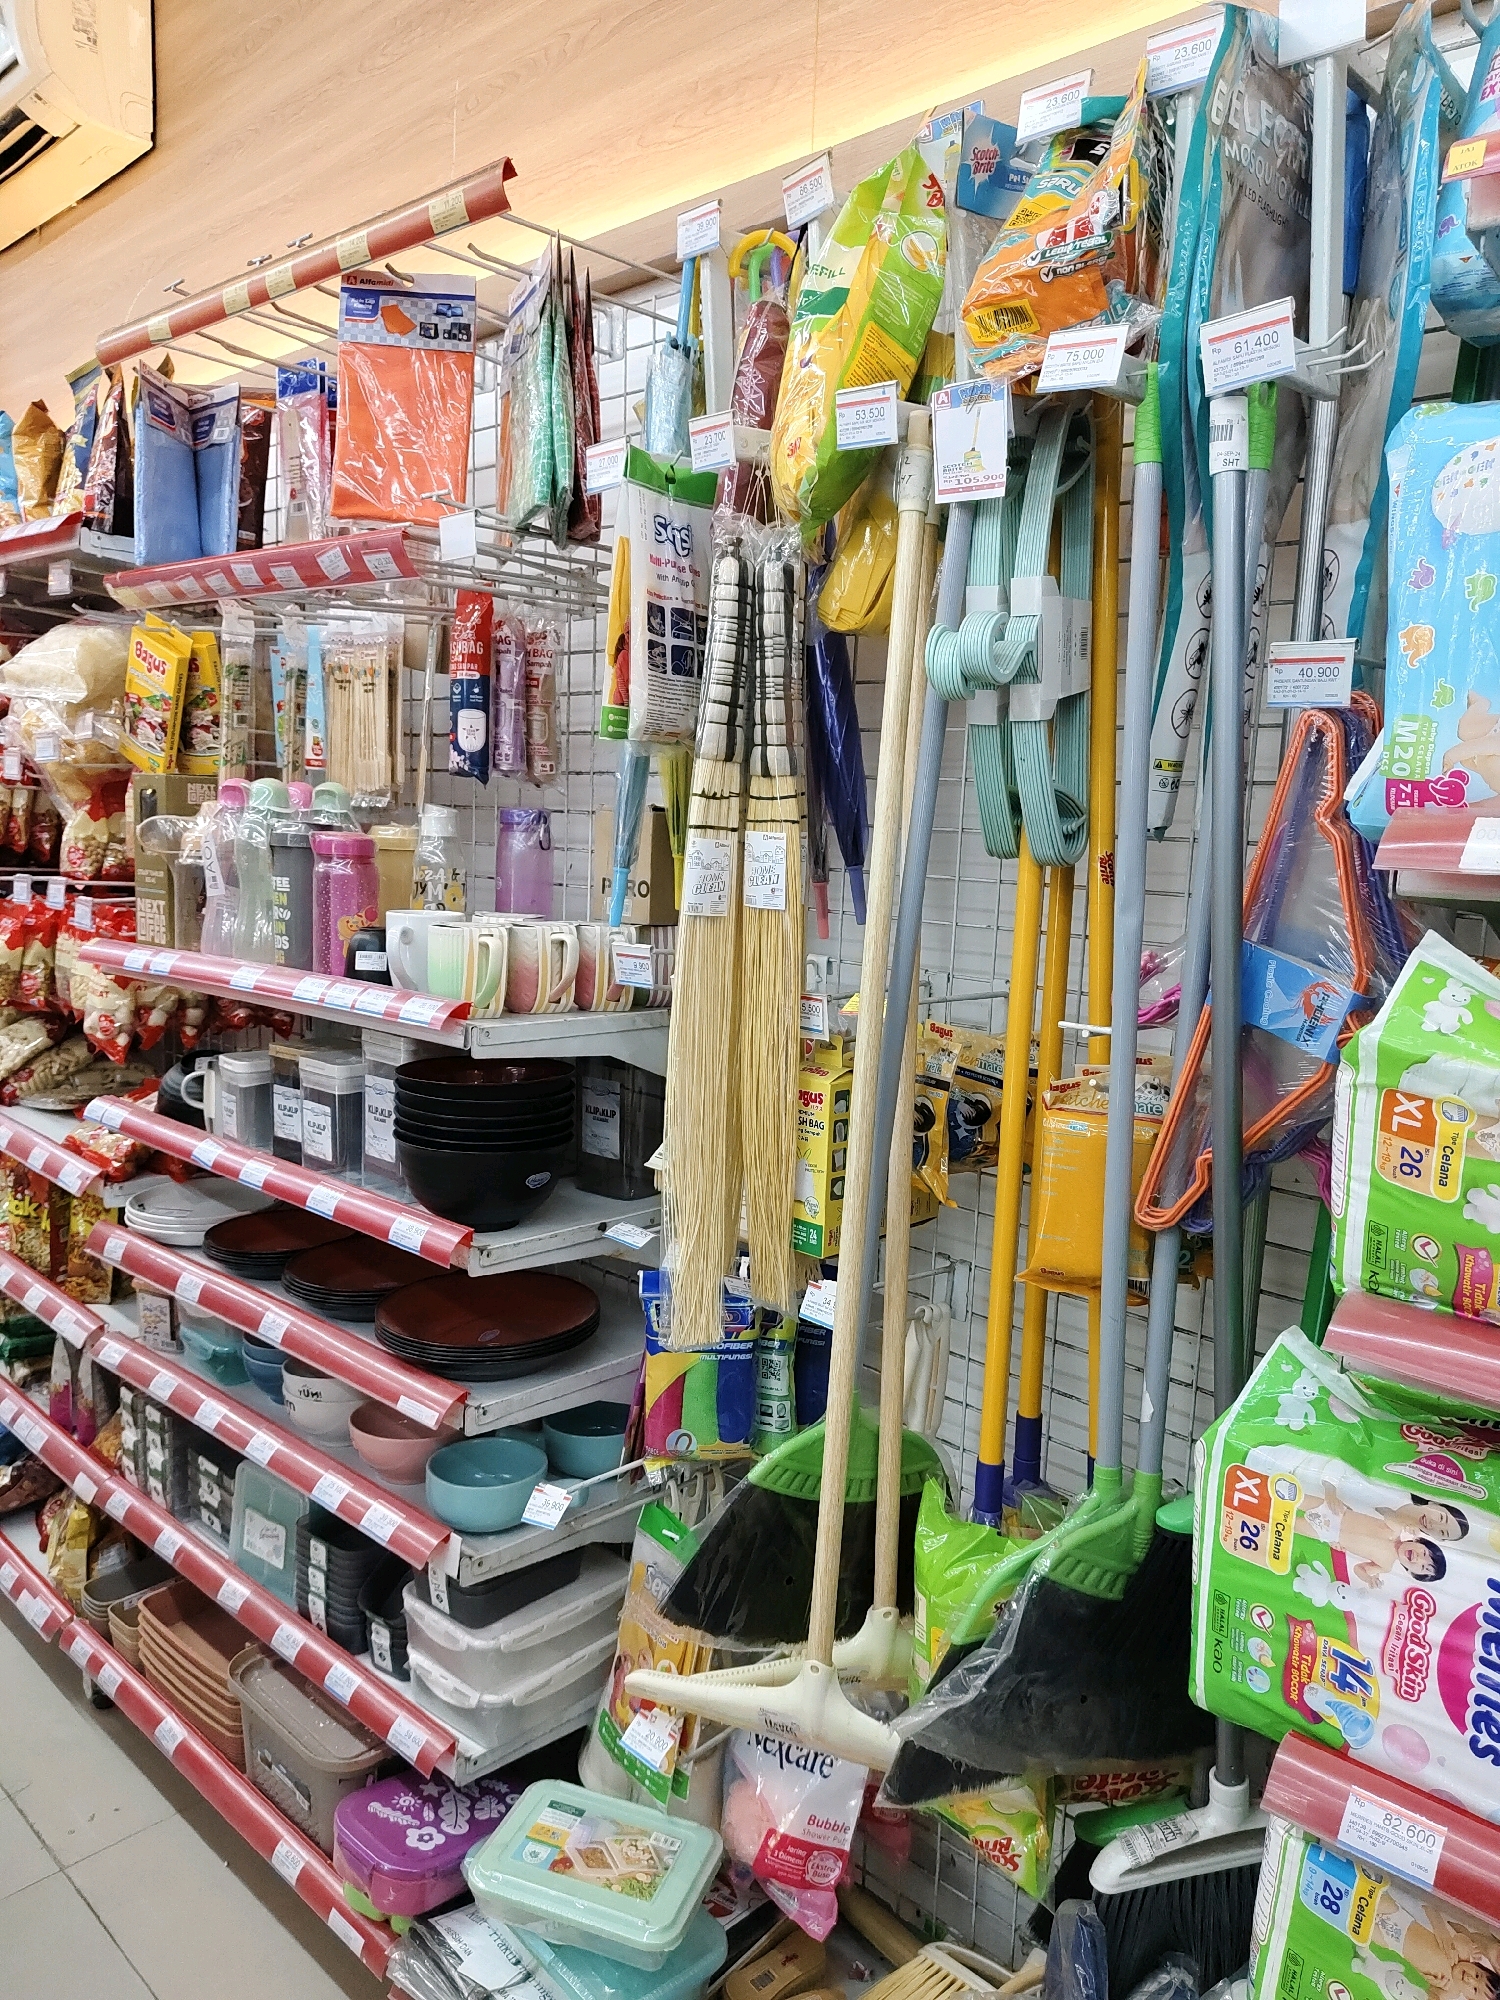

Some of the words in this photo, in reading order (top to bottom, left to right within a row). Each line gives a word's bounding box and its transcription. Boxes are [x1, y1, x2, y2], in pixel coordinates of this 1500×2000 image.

[1174, 38, 1212, 60] 23.600
[1045, 89, 1080, 109] 23.600
[972, 161, 995, 175] Brite
[696, 216, 717, 232] 39.900
[360, 278, 394, 286] Alfamidi
[807, 264, 846, 279] EFILL
[1234, 331, 1280, 354] 61.400
[1066, 348, 1105, 362] 75.000
[704, 431, 726, 446] 23.700
[598, 455, 619, 468] 27.000
[942, 461, 973, 469] SCOTCH
[1222, 458, 1240, 467] SHT
[954, 474, 1005, 486] 105.900
[134, 640, 168, 675] Bagus
[1274, 667, 1283, 675] Rp
[1298, 666, 1340, 678] 40.900
[1420, 721, 1429, 742] TIPE
[1414, 744, 1425, 779] CELANA
[1424, 747, 1435, 775] Diapers
[188, 783, 216, 793] NEXT
[692, 881, 725, 895] CLEAN
[748, 874, 779, 887] CLEAN
[137, 897, 166, 914] NEXT
[1266, 959, 1277, 989] Plastic
[1301, 991, 1331, 1046] PHOENIX
[929, 1022, 954, 1038] Bagus
[976, 1058, 1003, 1075] mate
[798, 1089, 824, 1108] agus
[1391, 1092, 1426, 1132] XL
[809, 1120, 825, 1131] BAG
[1449, 1131, 1460, 1146] Tipe
[1399, 1145, 1424, 1179] 26
[1438, 1145, 1455, 1188] Celana
[810, 1229, 818, 1240] 24
[1375, 1239, 1383, 1266] HALAL
[1463, 1253, 1476, 1297] Khawatir
[1474, 1283, 1489, 1311] Tidak
[700, 1353, 753, 1361] MULTIFUNGSI
[1434, 1472, 1459, 1487] kemasan
[1437, 1463, 1446, 1471] di
[1446, 1467, 1459, 1476] sini
[1232, 1469, 1262, 1507] XL
[1283, 1509, 1291, 1523] Tipe
[1239, 1519, 1261, 1552] 26
[1272, 1522, 1286, 1561] Celana
[1394, 1612, 1406, 1643] Cegah
[1212, 1638, 1224, 1674] kao
[1290, 1625, 1303, 1667] Khawatir
[1388, 1643, 1400, 1672] Iritasi
[1300, 1653, 1312, 1685] Tidak
[1319, 1658, 1327, 1684] SERAP
[1329, 1647, 1374, 1698] 14
[1289, 1666, 1301, 1703] BOCOR
[806, 1814, 851, 1835] Bubble
[1354, 1797, 1366, 1809] Rp
[1382, 1812, 1436, 1849] 82.600
[802, 1827, 831, 1843] Shower
[1319, 1879, 1344, 1915] 28
[1367, 1885, 1377, 1900] Tipe
[1351, 1896, 1370, 1937] Celana
[1289, 1969, 1297, 1994] HALAL
